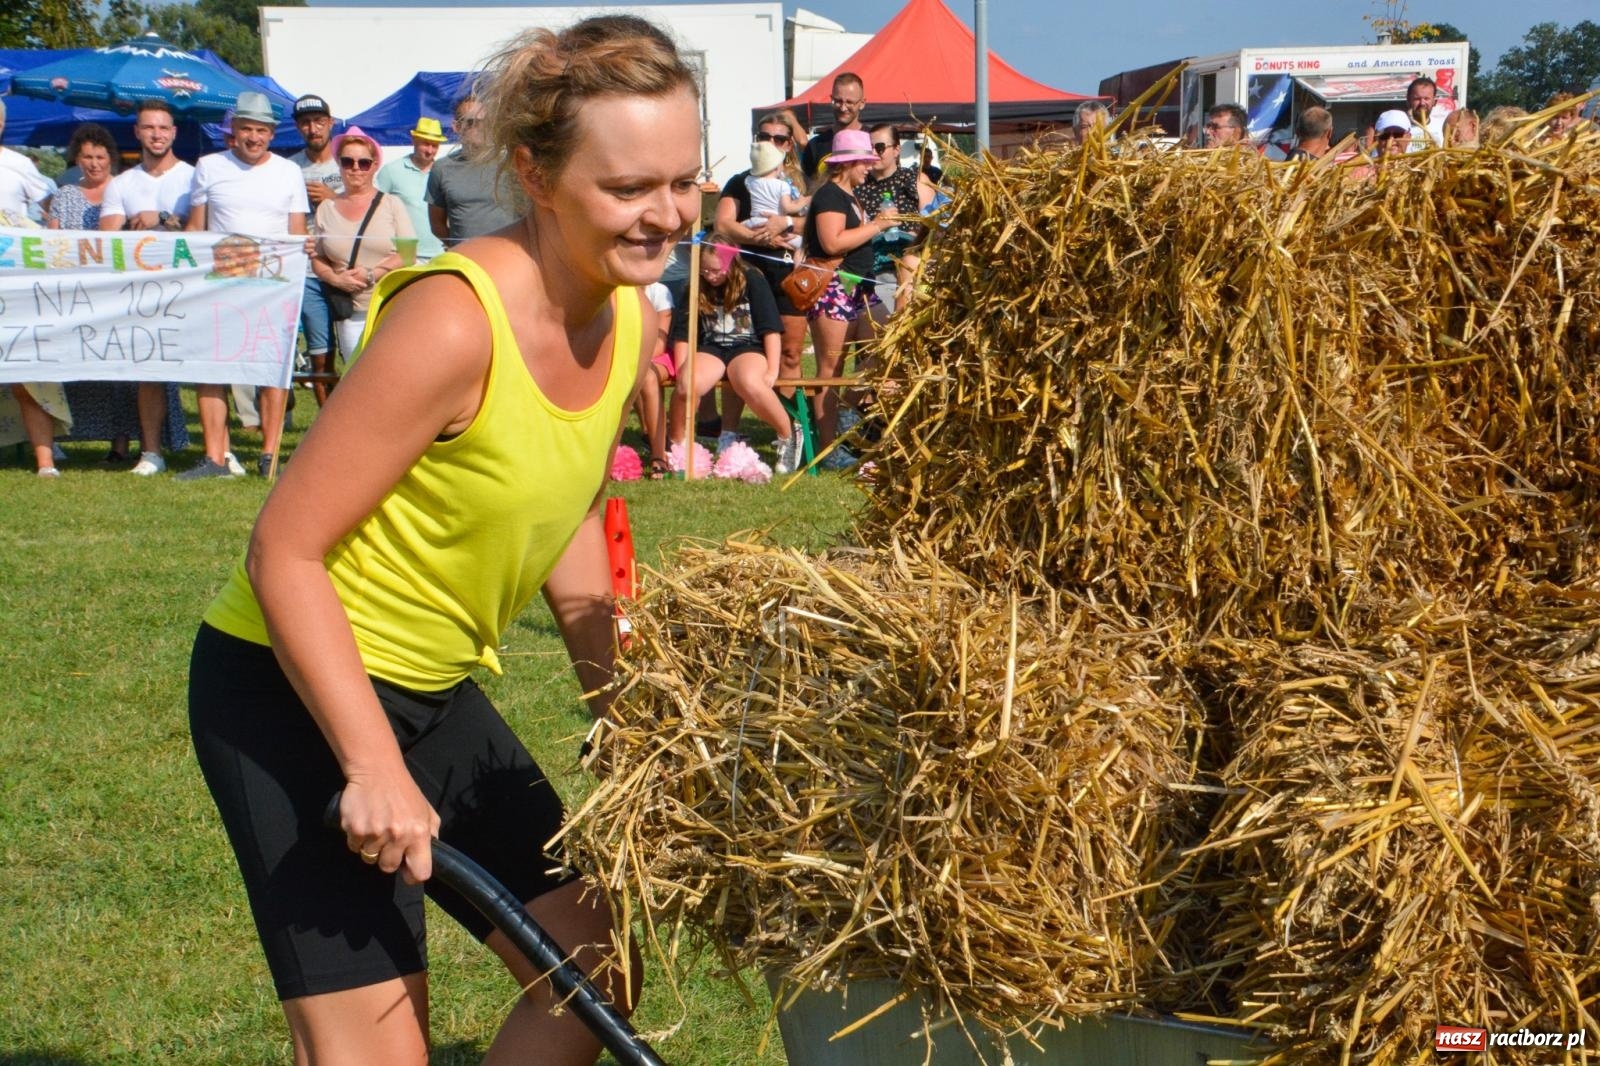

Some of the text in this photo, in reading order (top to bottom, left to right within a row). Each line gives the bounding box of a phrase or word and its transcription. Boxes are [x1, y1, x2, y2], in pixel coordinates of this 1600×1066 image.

[1255, 60, 1320, 71] DONUTS KING
[1347, 57, 1456, 68] and American Toast
[33, 280, 94, 317] NA
[120, 280, 186, 320] 102
[72, 323, 184, 366] RADE
